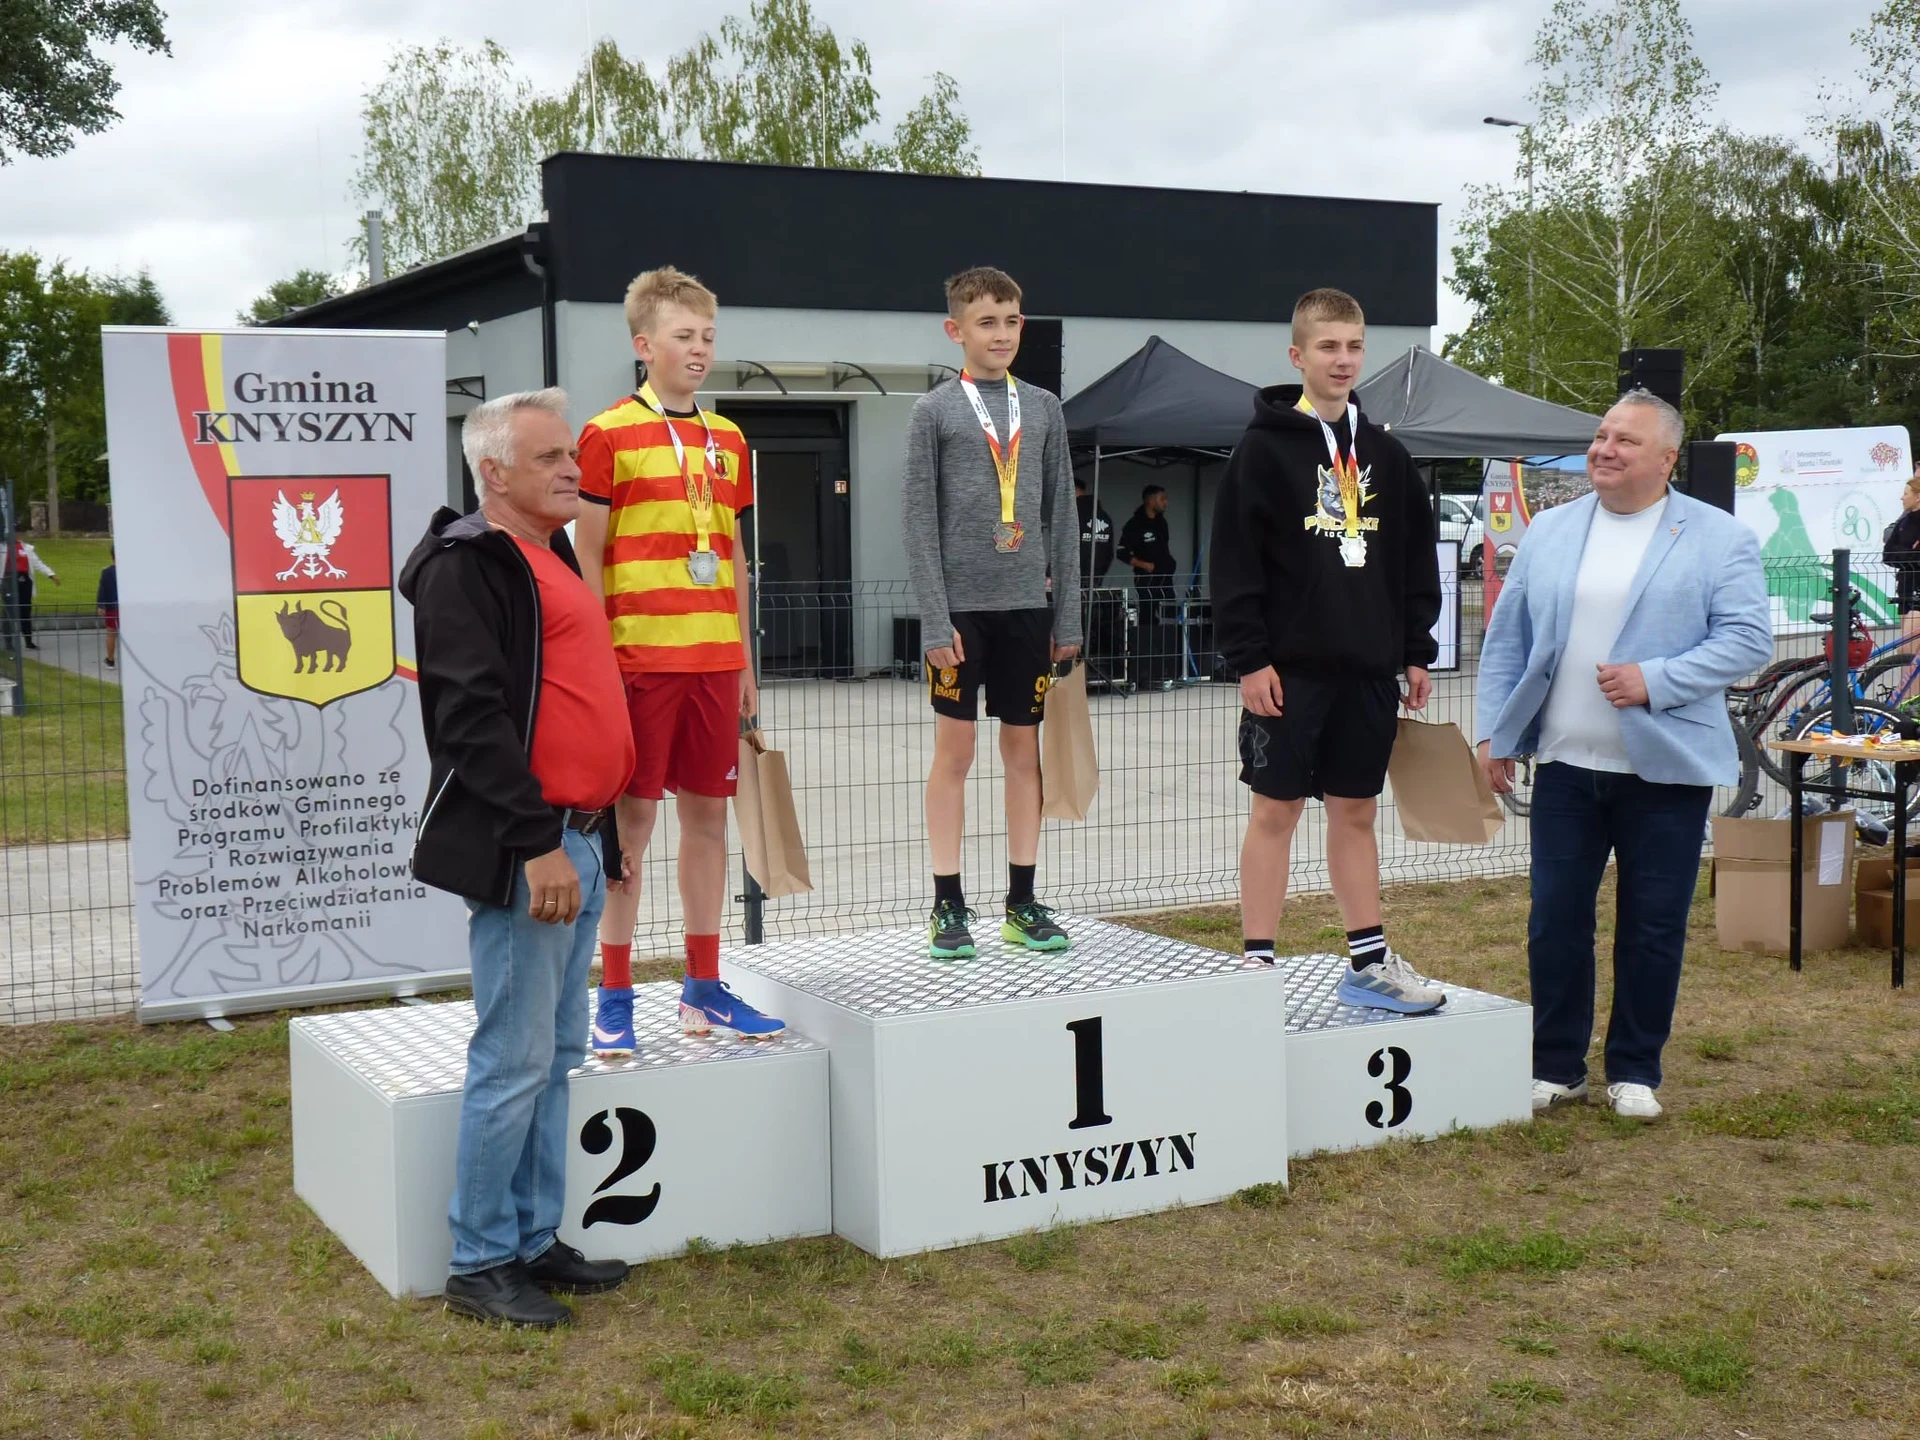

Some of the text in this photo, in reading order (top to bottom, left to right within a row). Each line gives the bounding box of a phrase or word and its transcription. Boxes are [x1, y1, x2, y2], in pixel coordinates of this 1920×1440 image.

[233, 371, 378, 404] Gmina
[194, 412, 417, 443] KNYSZYN
[193, 771, 401, 797] Dofinansowano ze
[189, 794, 406, 822] środków Gminnego
[178, 811, 419, 849] Programu Profilaktyki
[208, 842, 393, 868] i Rozwiązywania
[158, 862, 413, 898] Problemów Alkoholow
[180, 883, 426, 920] oraz Przeciwdziałania
[243, 910, 372, 939] Narkomanii
[1066, 1016, 1113, 1130] 1
[1364, 1046, 1413, 1129] 3
[579, 1107, 662, 1230] 2
[982, 1132, 1197, 1203] KNYSZYN
